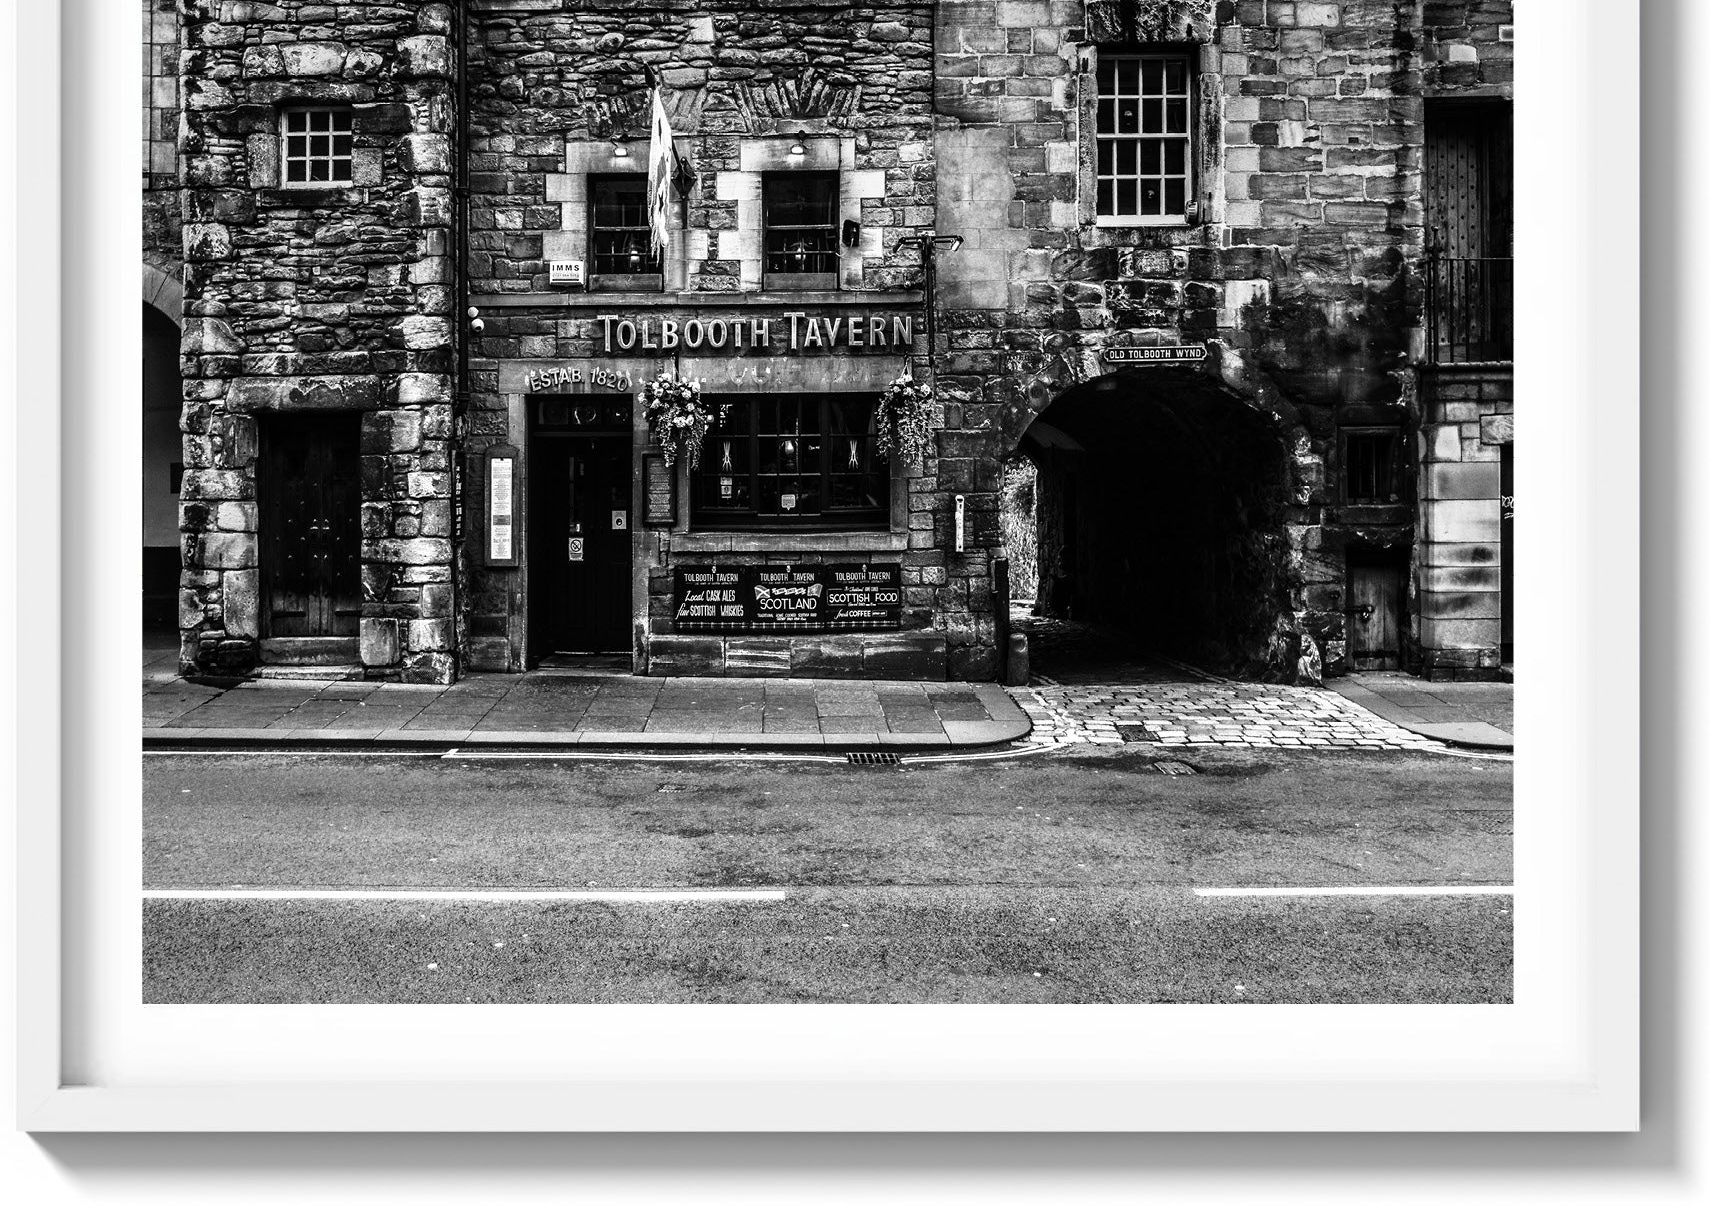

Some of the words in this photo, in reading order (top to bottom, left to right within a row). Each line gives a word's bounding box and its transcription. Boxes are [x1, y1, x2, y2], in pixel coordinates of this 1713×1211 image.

[552, 264, 580, 272] IMMS
[596, 314, 769, 352] TOLBOOTH
[783, 311, 913, 350] TAVERN
[1109, 350, 1125, 359] OLD
[1128, 349, 1171, 359] TOLBOOTH
[1175, 348, 1201, 358] WYND
[590, 368, 629, 392] 1820
[683, 573, 714, 582] TOLBOOTH
[716, 573, 739, 582] TAVERN
[760, 573, 789, 582] TOLBOOTH
[793, 572, 815, 581] TAVERN
[835, 572, 866, 581] TOLBOOTH
[868, 571, 891, 580] TAVERN
[685, 590, 705, 602] Local
[706, 589, 721, 602] CASK
[722, 589, 736, 602] ALES
[829, 592, 870, 605] SCOTTISH
[875, 592, 898, 602] FOOD
[760, 598, 817, 610] SCOTLAND
[689, 605, 716, 617] SCOTTISH
[848, 610, 872, 618] COFFEE
